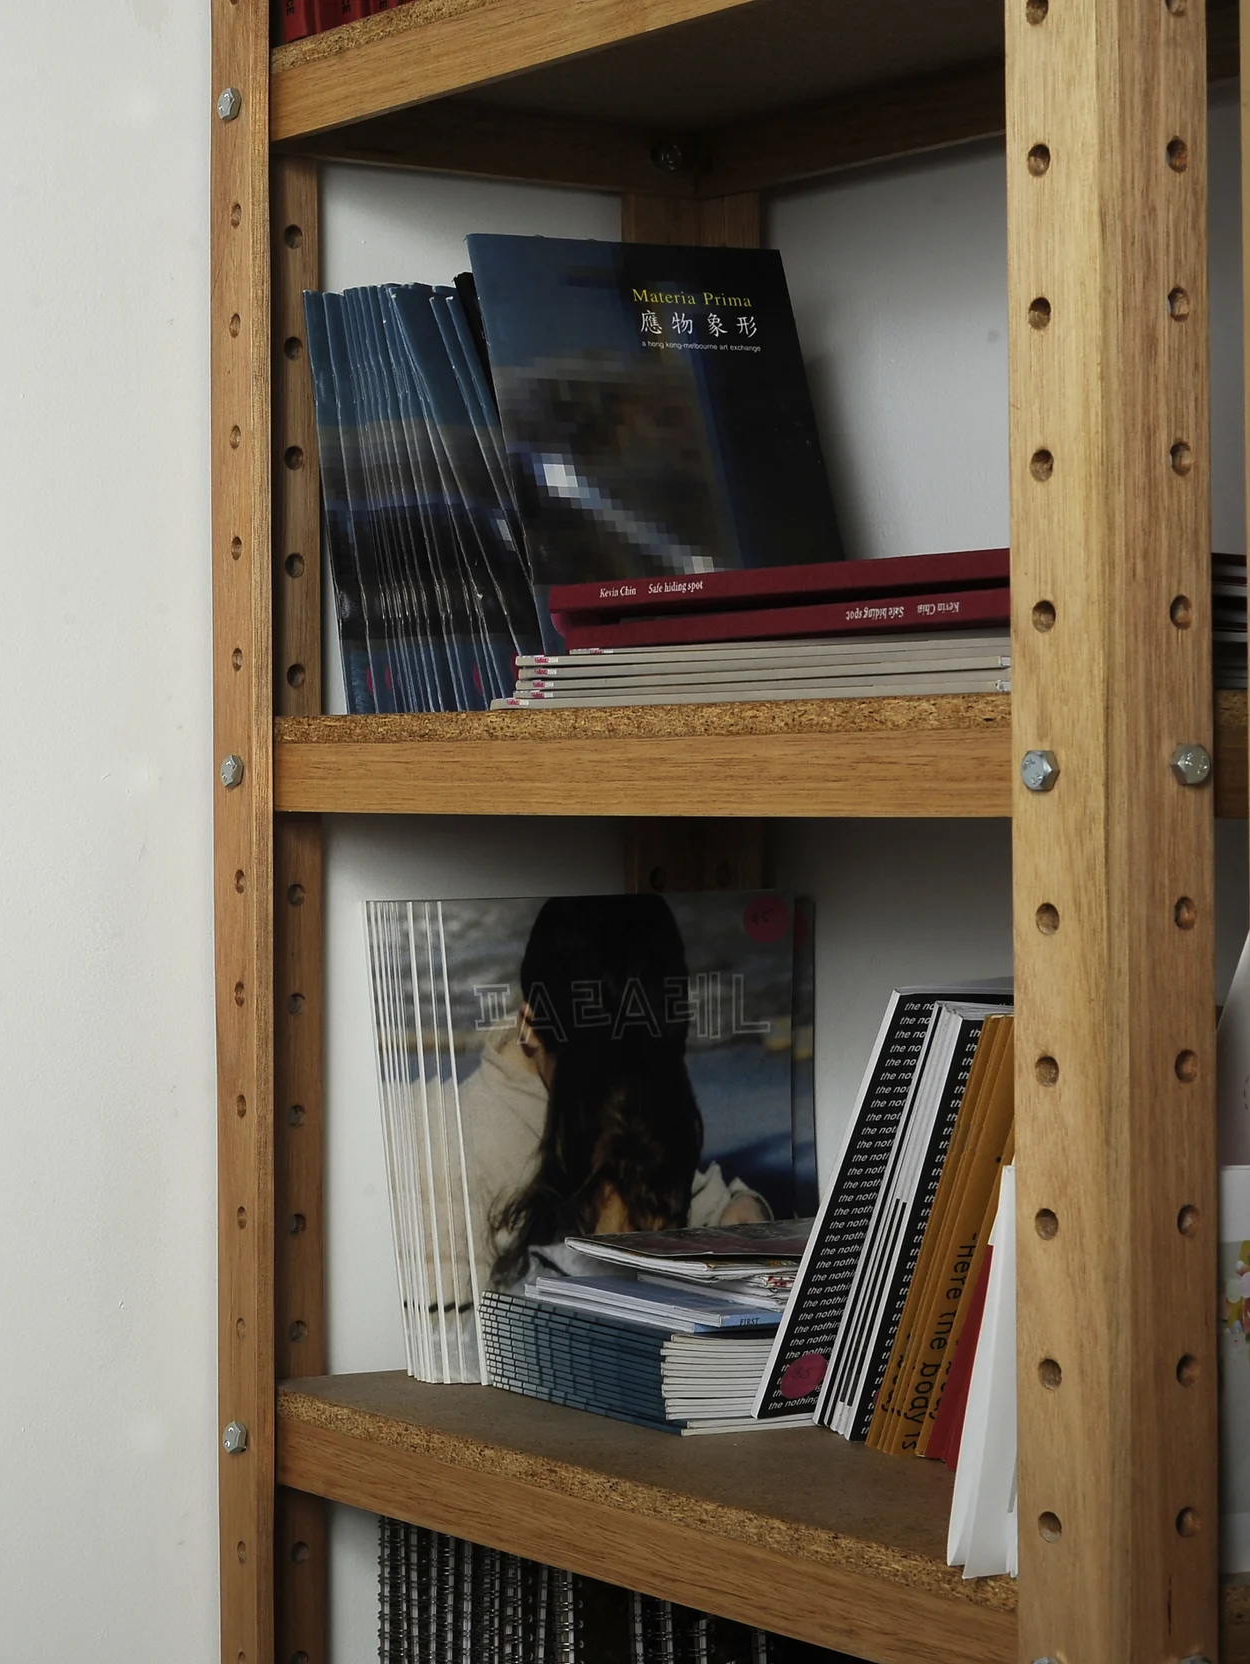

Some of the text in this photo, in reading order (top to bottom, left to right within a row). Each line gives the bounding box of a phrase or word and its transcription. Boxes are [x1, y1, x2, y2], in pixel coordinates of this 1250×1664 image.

[632, 288, 752, 307] Materia Prima
[648, 340, 664, 350] hong
[666, 341, 718, 350] kong-melbourne
[730, 344, 762, 353] exchange
[600, 580, 703, 598] Kevin Chin Safe hiding spot
[846, 602, 960, 620] Kevin Chin Safe hiding spot
[904, 1002, 920, 1010] the
[895, 1030, 911, 1038] the
[969, 1029, 981, 1037] th
[966, 1043, 977, 1051] th
[885, 1058, 901, 1066] the
[880, 1072, 896, 1080] the
[876, 1086, 891, 1094] the
[871, 1099, 886, 1107] the
[866, 1113, 881, 1121] the
[947, 1113, 957, 1121] th
[861, 1127, 877, 1135] the
[943, 1127, 953, 1135] th
[857, 1140, 872, 1148] the
[852, 1154, 867, 1162] the
[935, 1154, 946, 1162] th
[847, 1167, 863, 1175] the
[838, 1192, 878, 1202] the noth
[924, 1195, 935, 1203] th
[834, 1205, 874, 1216] the noth
[830, 1221, 844, 1229] the
[825, 1234, 840, 1242] the
[910, 1248, 920, 1256] th
[833, 1257, 860, 1266] nothi
[812, 1274, 826, 1282] the
[798, 1309, 844, 1320] the nothin
[740, 1317, 760, 1326] FIRST
[811, 1322, 840, 1331] nothin
[790, 1334, 836, 1346] the nothin
[786, 1351, 800, 1359] the
